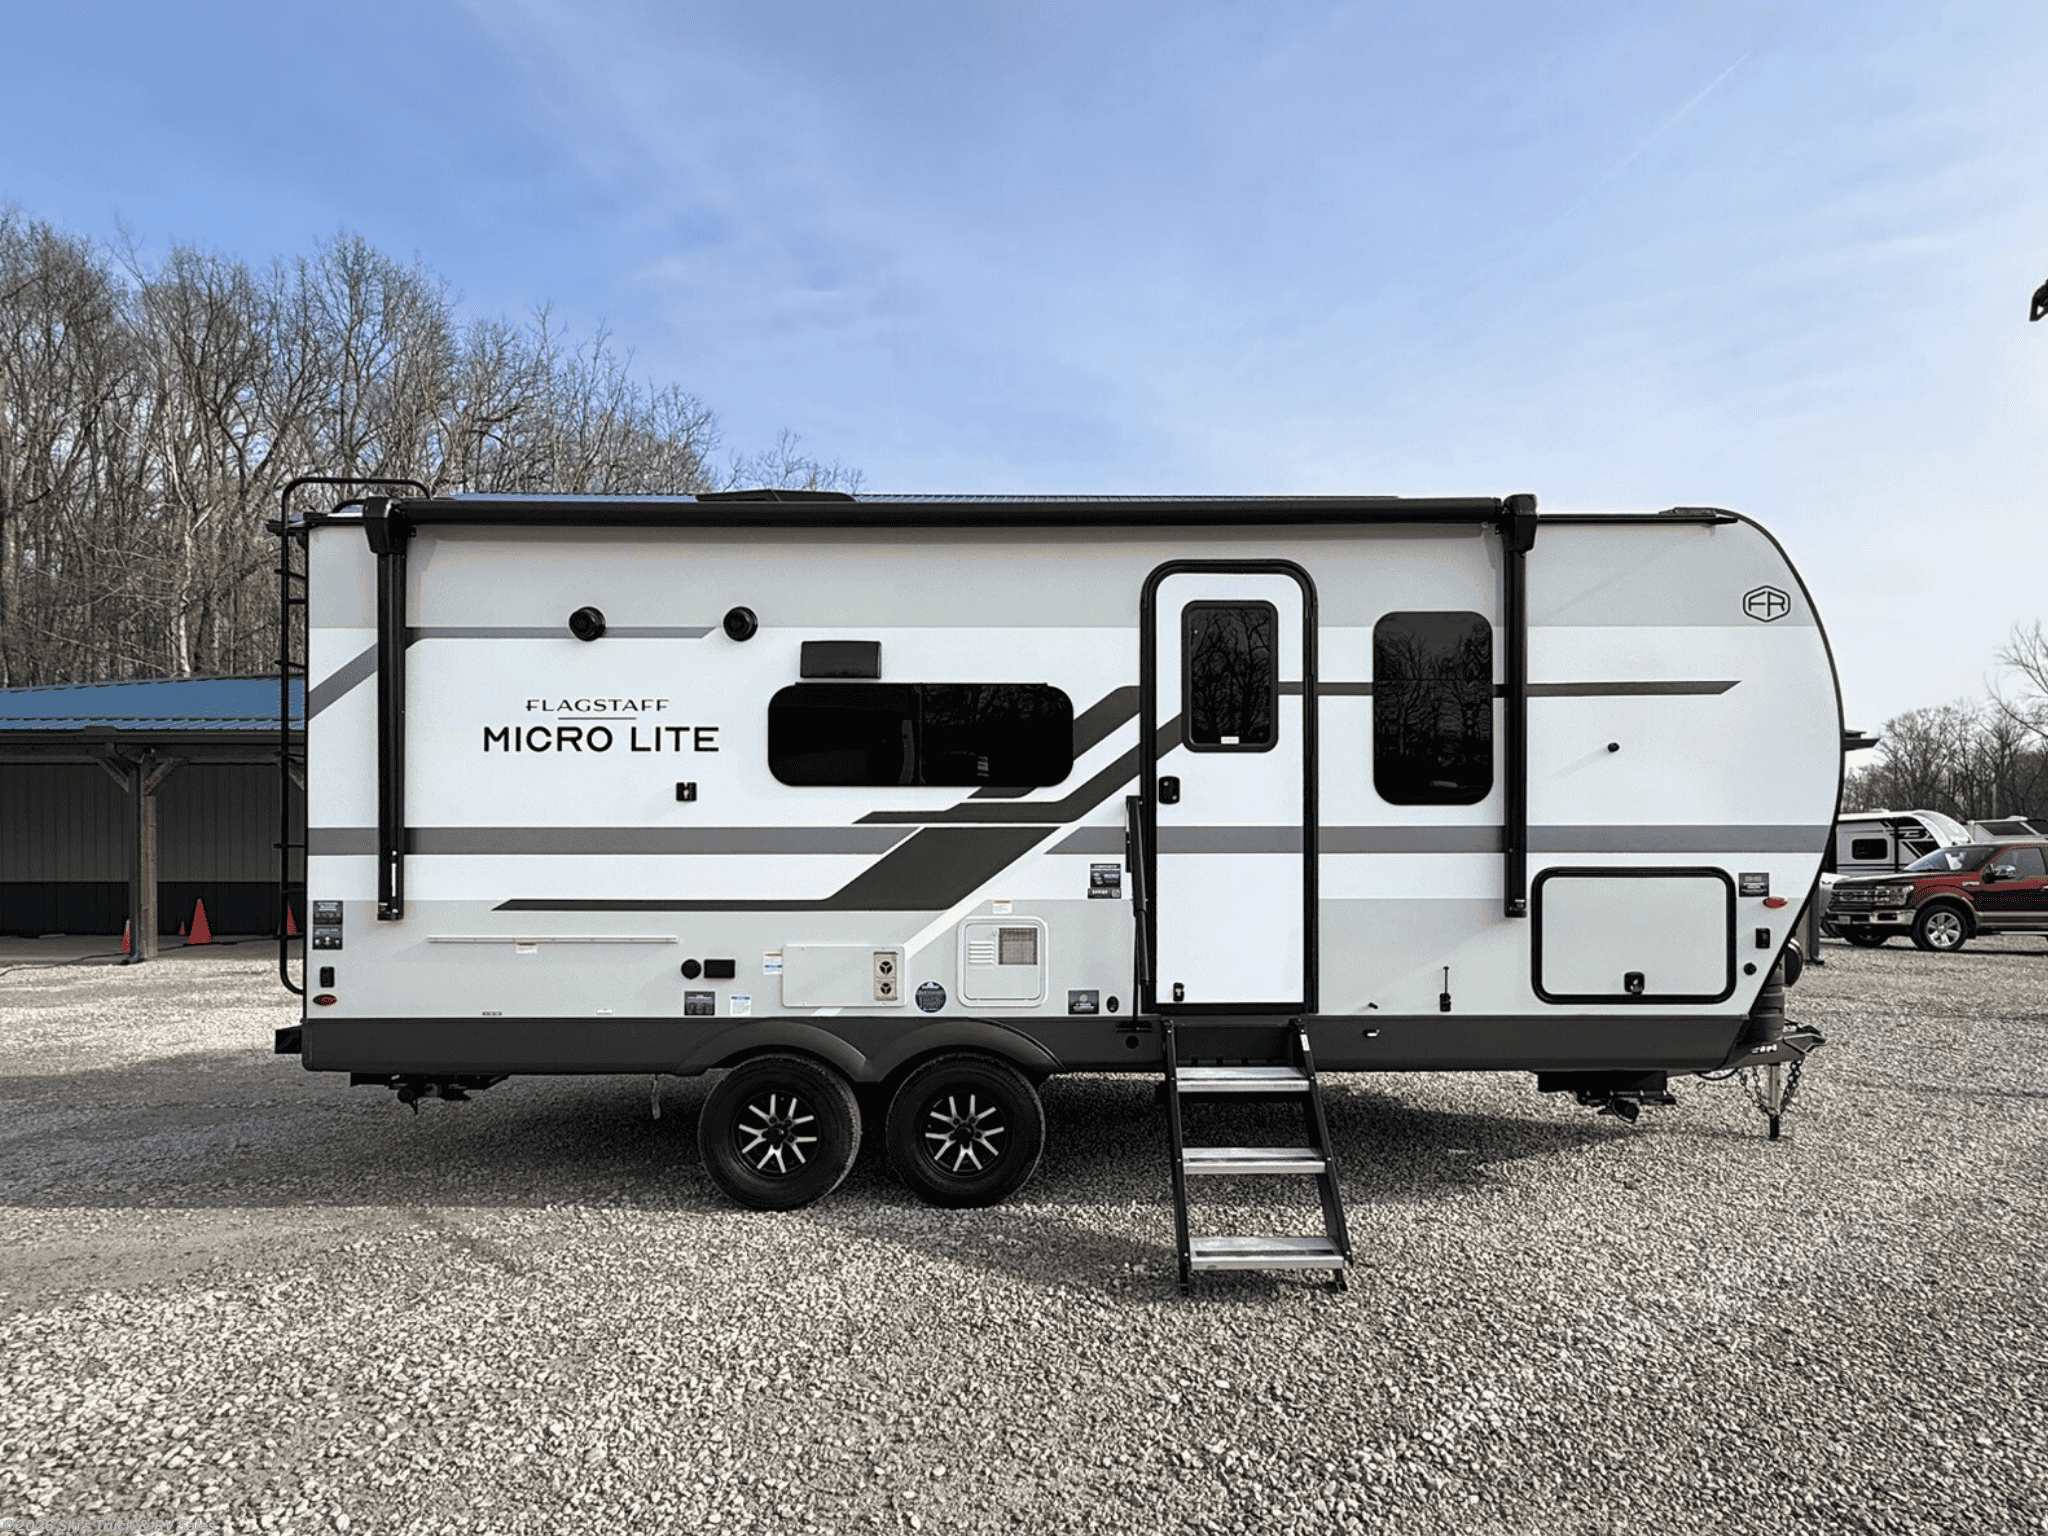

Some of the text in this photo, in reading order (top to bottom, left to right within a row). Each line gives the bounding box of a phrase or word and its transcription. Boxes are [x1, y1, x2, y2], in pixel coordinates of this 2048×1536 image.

[525, 698, 670, 712] FLAGSTAFF
[483, 725, 720, 752] MICRO LITE
